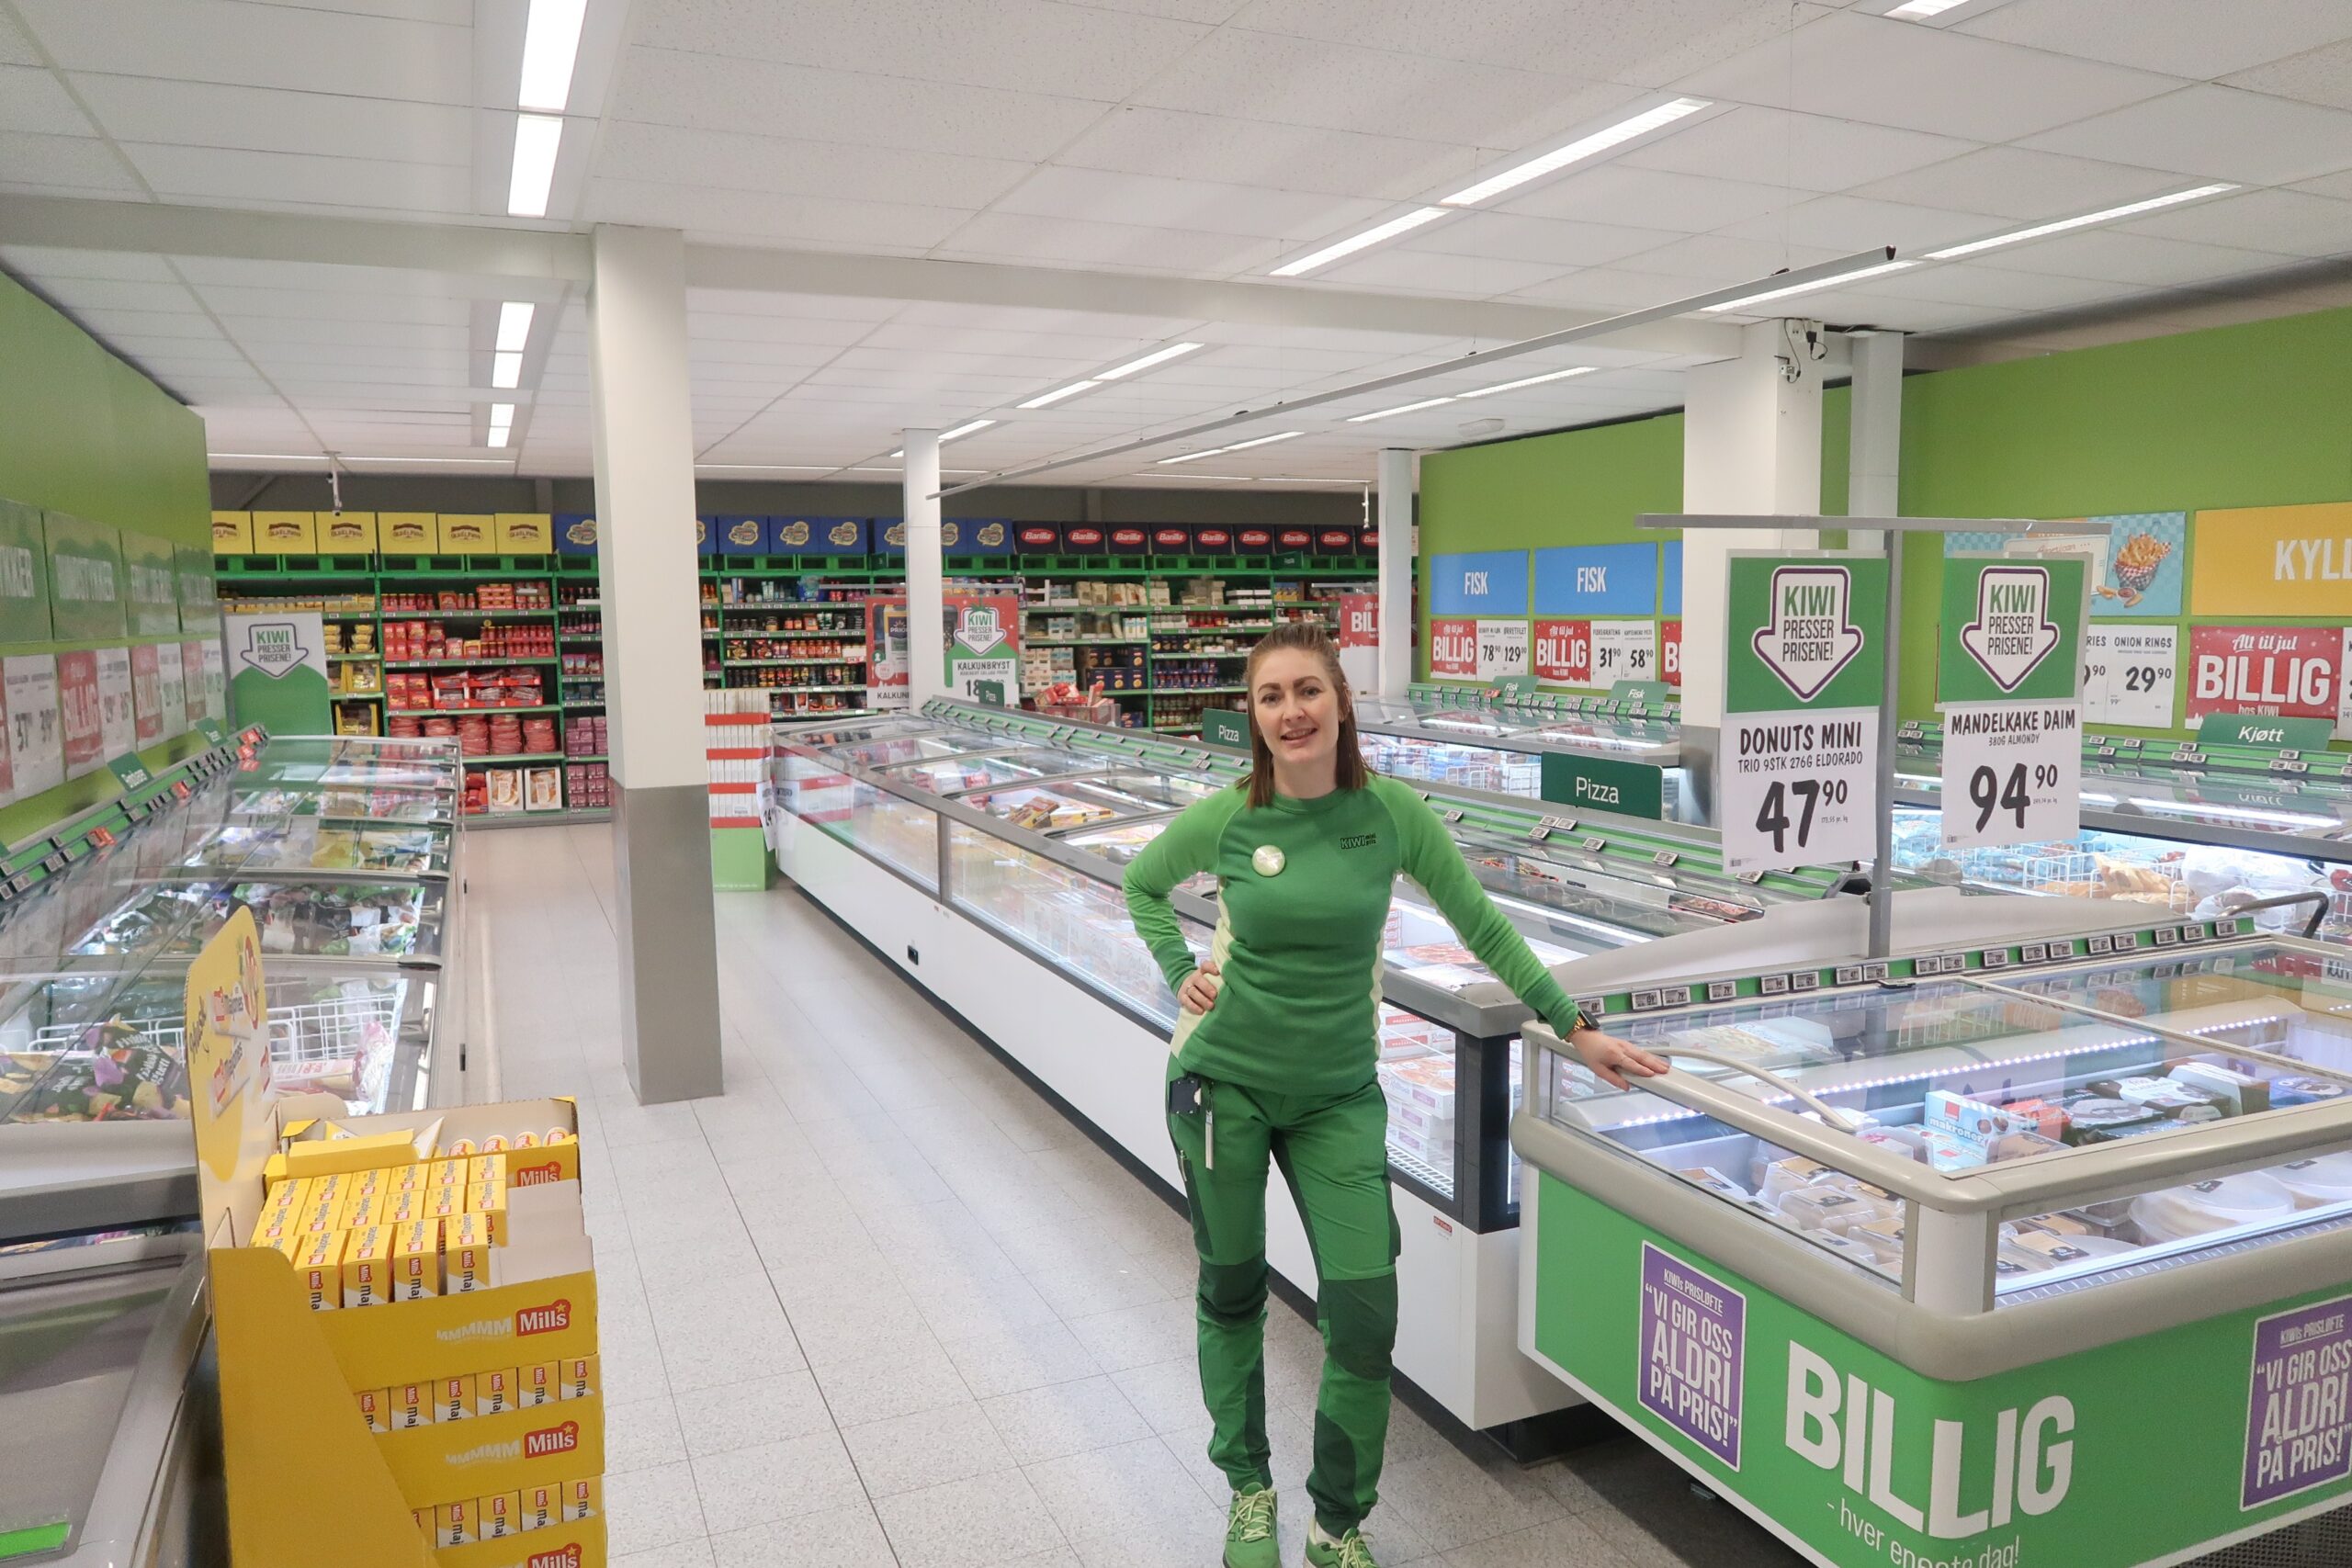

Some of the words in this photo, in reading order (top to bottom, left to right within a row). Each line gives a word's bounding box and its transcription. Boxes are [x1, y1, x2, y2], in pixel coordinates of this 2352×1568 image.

[1025, 532, 1051, 540] Barilla
[1116, 533, 1141, 541] Barilla
[1159, 533, 1183, 541] Barilla
[1325, 535, 1347, 543] Barilla
[1464, 571, 1488, 595] FISK
[1577, 566, 1607, 592] FISK
[1784, 585, 1836, 617] KIWI
[1990, 584, 2036, 614] KIWI
[968, 615, 992, 626] KIWI
[1783, 619, 1834, 640] PRESSER
[1988, 615, 2034, 636] PRESSER
[256, 630, 289, 644] KIWI
[1987, 637, 2033, 656] PRISENE!
[2114, 637, 2143, 648] ONION
[2145, 637, 2172, 649] RINGS
[2233, 634, 2256, 654] Alt
[2258, 635, 2273, 650] til
[2271, 635, 2298, 654] jul
[257, 644, 291, 653] PRESSER
[258, 653, 291, 663] PRISENE!
[1433, 636, 1475, 663] BILLIG
[1536, 638, 1587, 669] BILLIG
[1600, 648, 1612, 668] 31
[1630, 649, 1645, 668] 58
[1782, 641, 1834, 662] PRISENE!
[957, 661, 1011, 671] KALKUNBRYST
[2093, 665, 2106, 676] 90
[1505, 683, 1520, 692] Fisk
[2126, 666, 2156, 693] 29
[2157, 668, 2172, 680] 90
[2196, 654, 2332, 705] BILLIG
[1628, 689, 1645, 699] Fisk
[1218, 724, 1239, 742] Pizza
[1951, 711, 2039, 736] MANDELKAKE
[2043, 709, 2075, 731] DAIM
[1740, 724, 1815, 756] DONUTS
[1821, 721, 1862, 748] MINI
[1988, 735, 2006, 747] 380G
[2007, 733, 2040, 746] ALMONDY
[2238, 726, 2285, 743] Kjøtt
[1738, 757, 1760, 773] TRIO
[1764, 757, 1787, 772] 9STK
[1790, 755, 1813, 771] 276G
[1815, 751, 1863, 769] ELDORADO
[1577, 777, 1620, 804] Pizza
[1970, 762, 2030, 833] 94
[2035, 764, 2058, 789] 90
[1756, 779, 1821, 853] 47
[1822, 779, 1849, 807] 90
[1340, 835, 1366, 850] KIWI
[1929, 1117, 1984, 1143] makroner
[520, 1169, 559, 1187] Mills
[1664, 1268, 1683, 1291] KIWIs
[1685, 1280, 1724, 1314] PRISLØFTE
[520, 1310, 567, 1333] Mills
[1672, 1299, 1697, 1338] GIR
[1702, 1317, 1733, 1359] OSS
[2280, 1326, 2302, 1346] KIWIs
[2303, 1314, 2345, 1339] PRISLØFTE
[1652, 1319, 1731, 1411] ALDRI
[2288, 1349, 2316, 1386] GIR
[2319, 1339, 2352, 1376] OSS
[1650, 1363, 1674, 1411] PÅ
[2260, 1372, 2349, 1448] ALDRI
[529, 1433, 574, 1455] Mills
[1785, 1339, 2075, 1539] BILLIG
[2256, 1435, 2284, 1489] PÅ
[1841, 1497, 1885, 1551] hver
[1979, 1535, 2020, 1568] dag!
[531, 1554, 577, 1568] Mills
